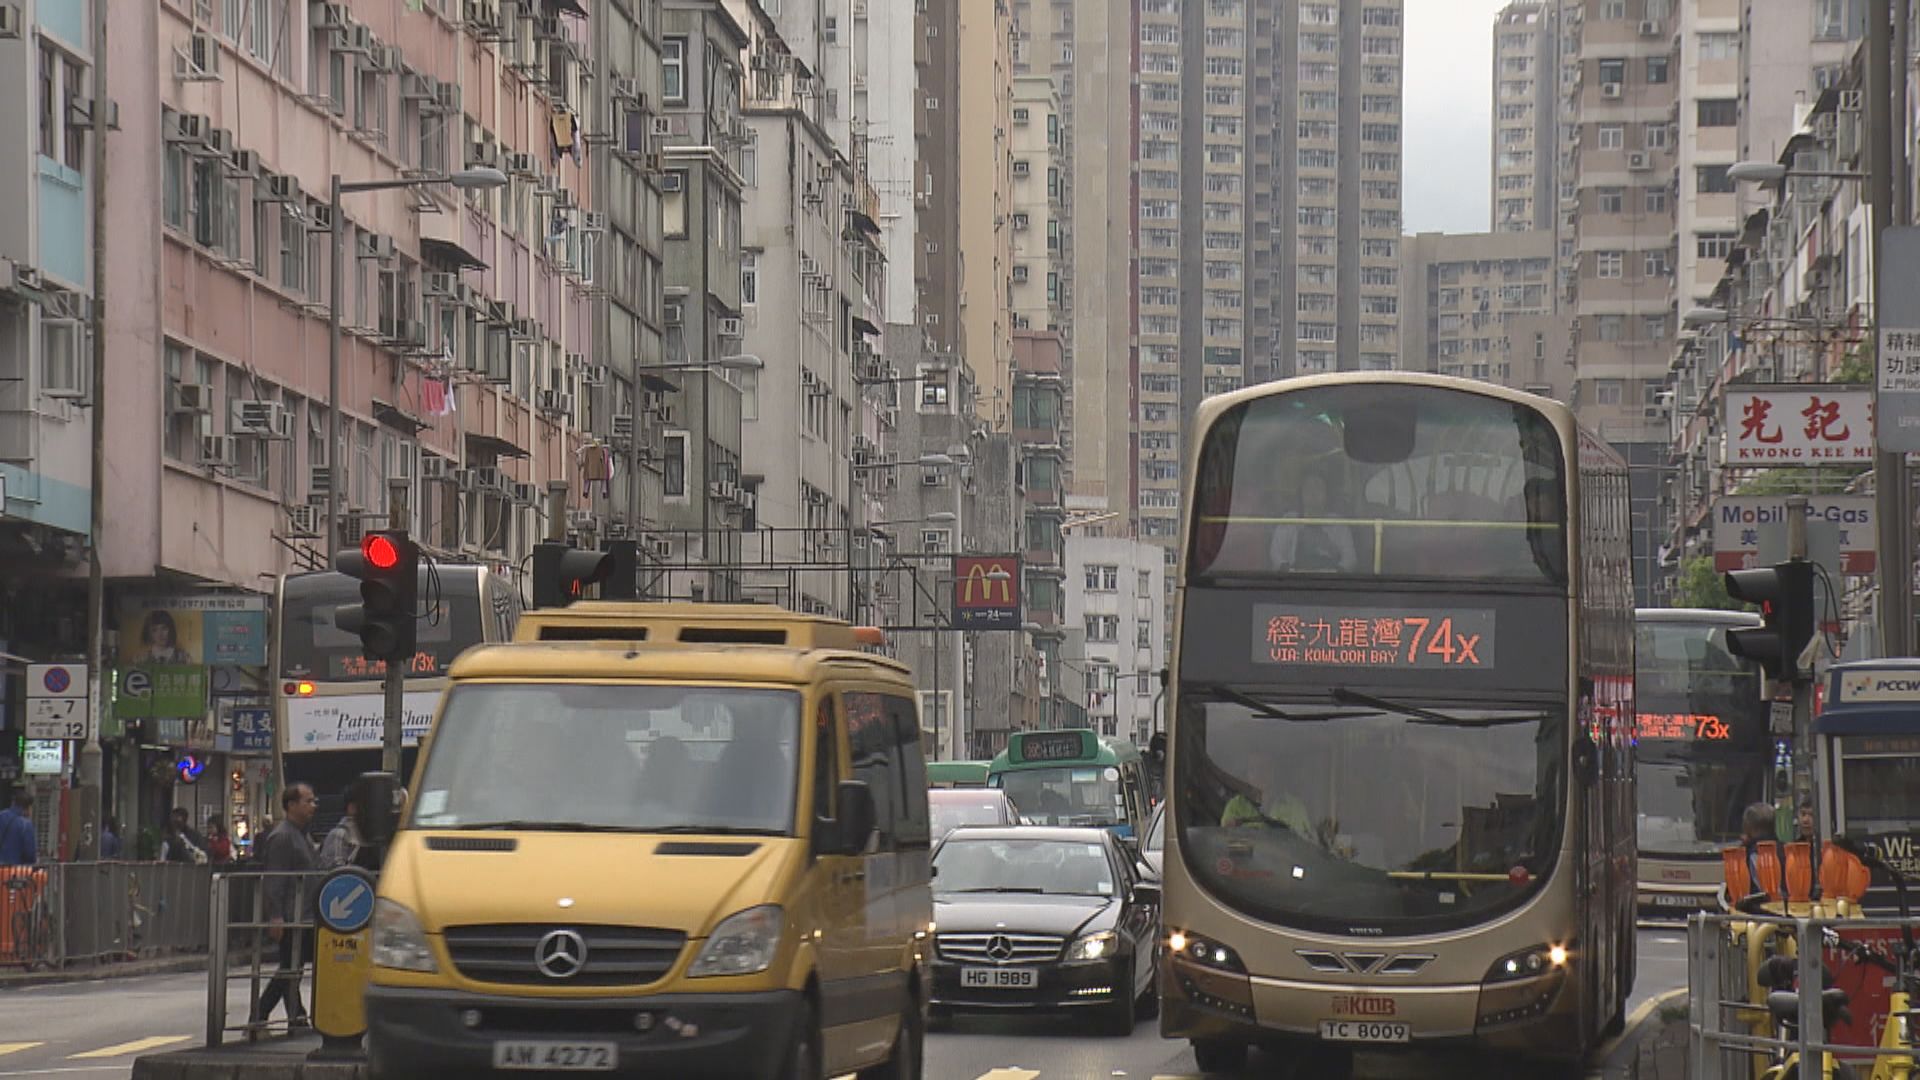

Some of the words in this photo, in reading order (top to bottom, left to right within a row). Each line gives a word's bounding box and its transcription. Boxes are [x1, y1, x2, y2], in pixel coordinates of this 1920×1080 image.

[1739, 396, 1876, 443] 光記
[1739, 447, 1802, 458] KWONG
[1811, 447, 1845, 458] KEE
[1722, 505, 1783, 524] Mobil
[1803, 505, 1869, 524] P-Gas
[1403, 617, 1480, 664] 74x
[1304, 650, 1366, 665] KOWLOON
[1370, 650, 1399, 665] BAY
[1876, 679, 1920, 692] PCCW
[64, 700, 75, 714] 7
[337, 712, 385, 729] Patric
[1695, 715, 1730, 739] 73x
[65, 722, 84, 737] 12
[336, 728, 377, 743] English
[966, 971, 988, 984] HG
[1350, 995, 1397, 1016] KMB
[1327, 1022, 1350, 1037] TC
[1358, 1023, 1406, 1040] 8009
[544, 1046, 609, 1067] 4272
